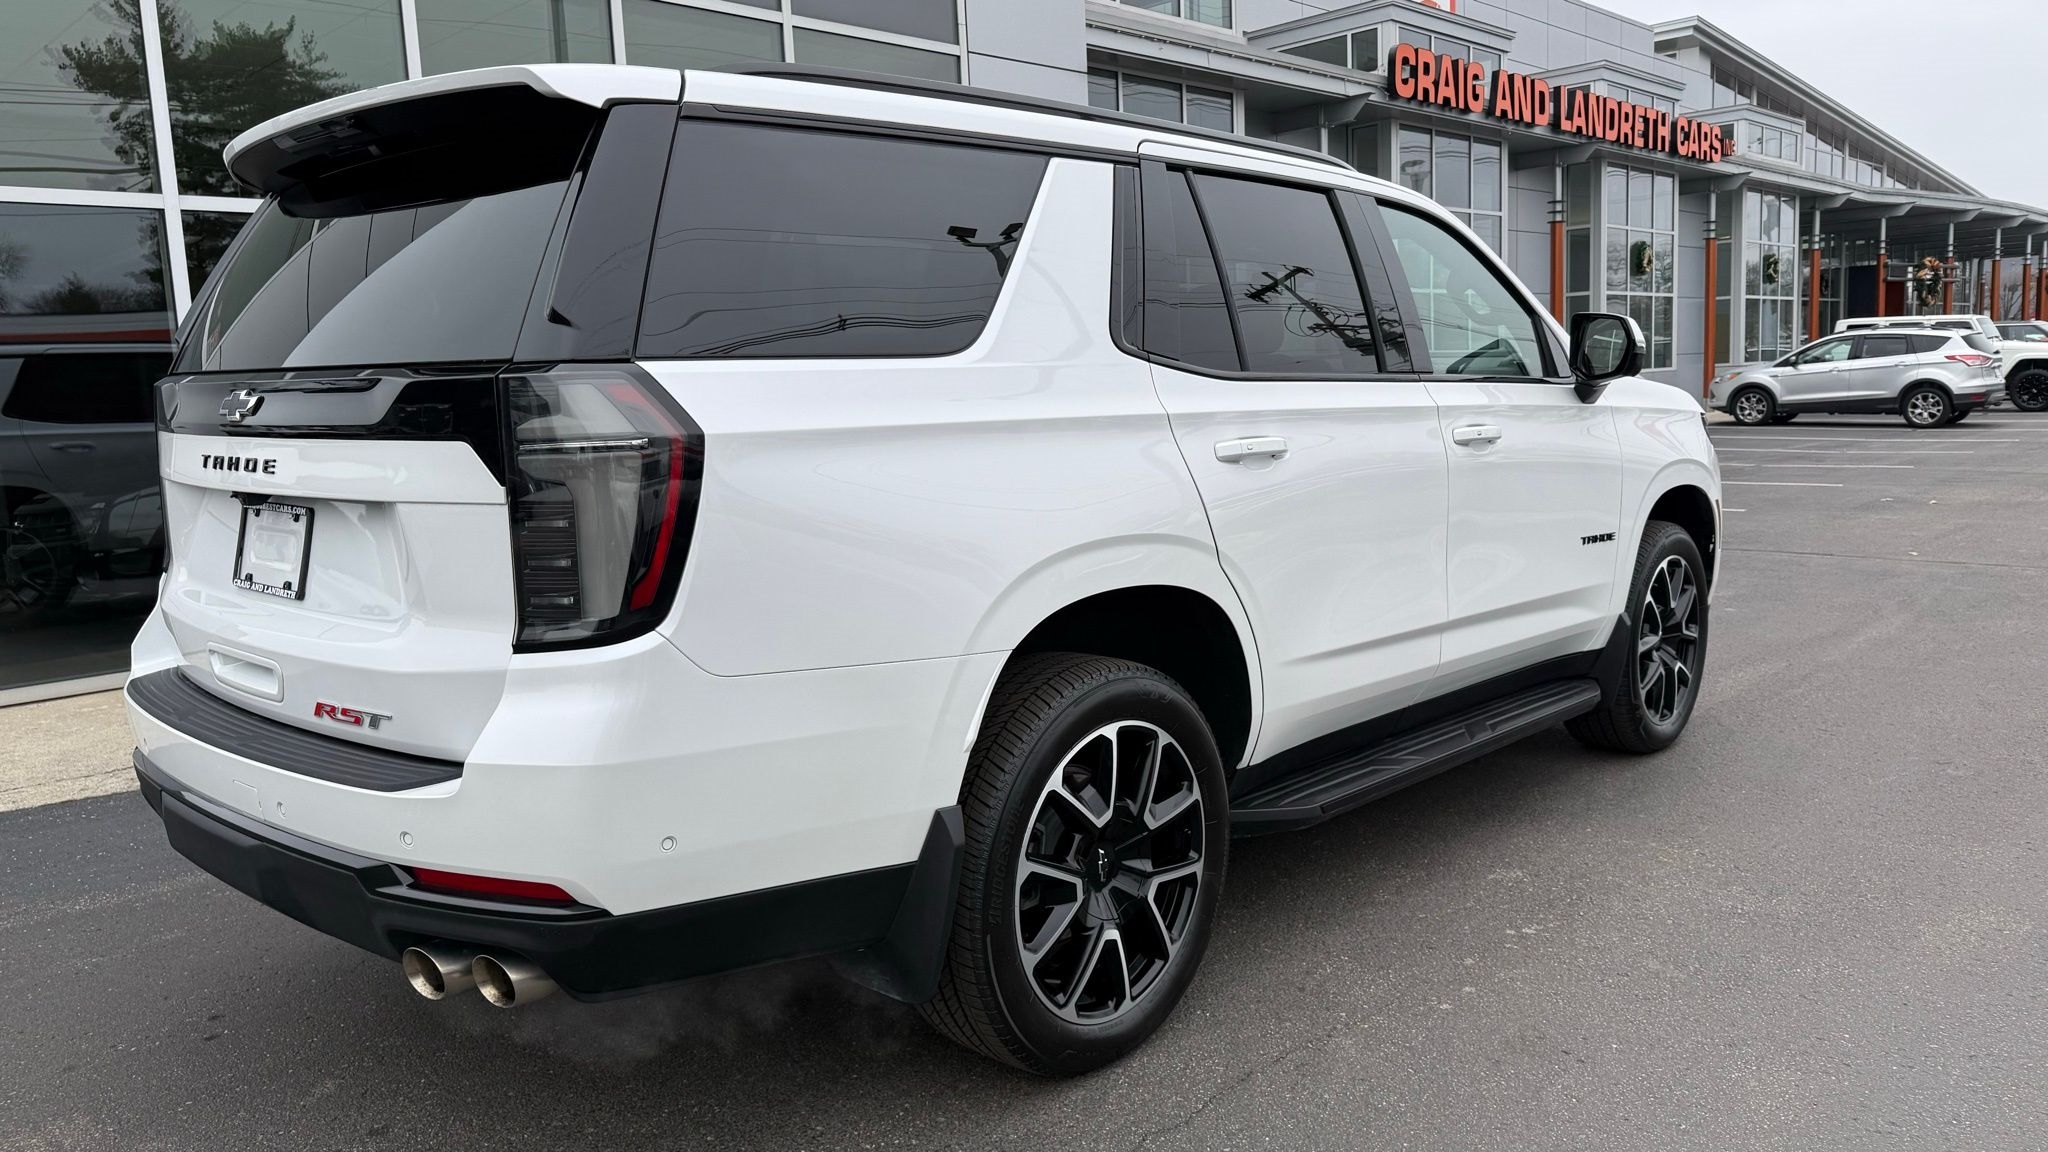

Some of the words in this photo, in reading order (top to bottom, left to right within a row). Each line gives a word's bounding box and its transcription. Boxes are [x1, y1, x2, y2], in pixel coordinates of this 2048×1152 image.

[1395, 43, 1484, 113] CRAIG
[1495, 69, 1550, 126] AND
[1560, 85, 1670, 153] LANDRETH
[1677, 116, 1722, 163] CARS
[201, 454, 276, 475] TAHOE
[1580, 531, 1616, 546] TAHOE
[233, 578, 251, 588] CRAIG
[251, 583, 264, 592] AND
[264, 585, 297, 599] LANDRETH
[314, 701, 393, 730] RST
